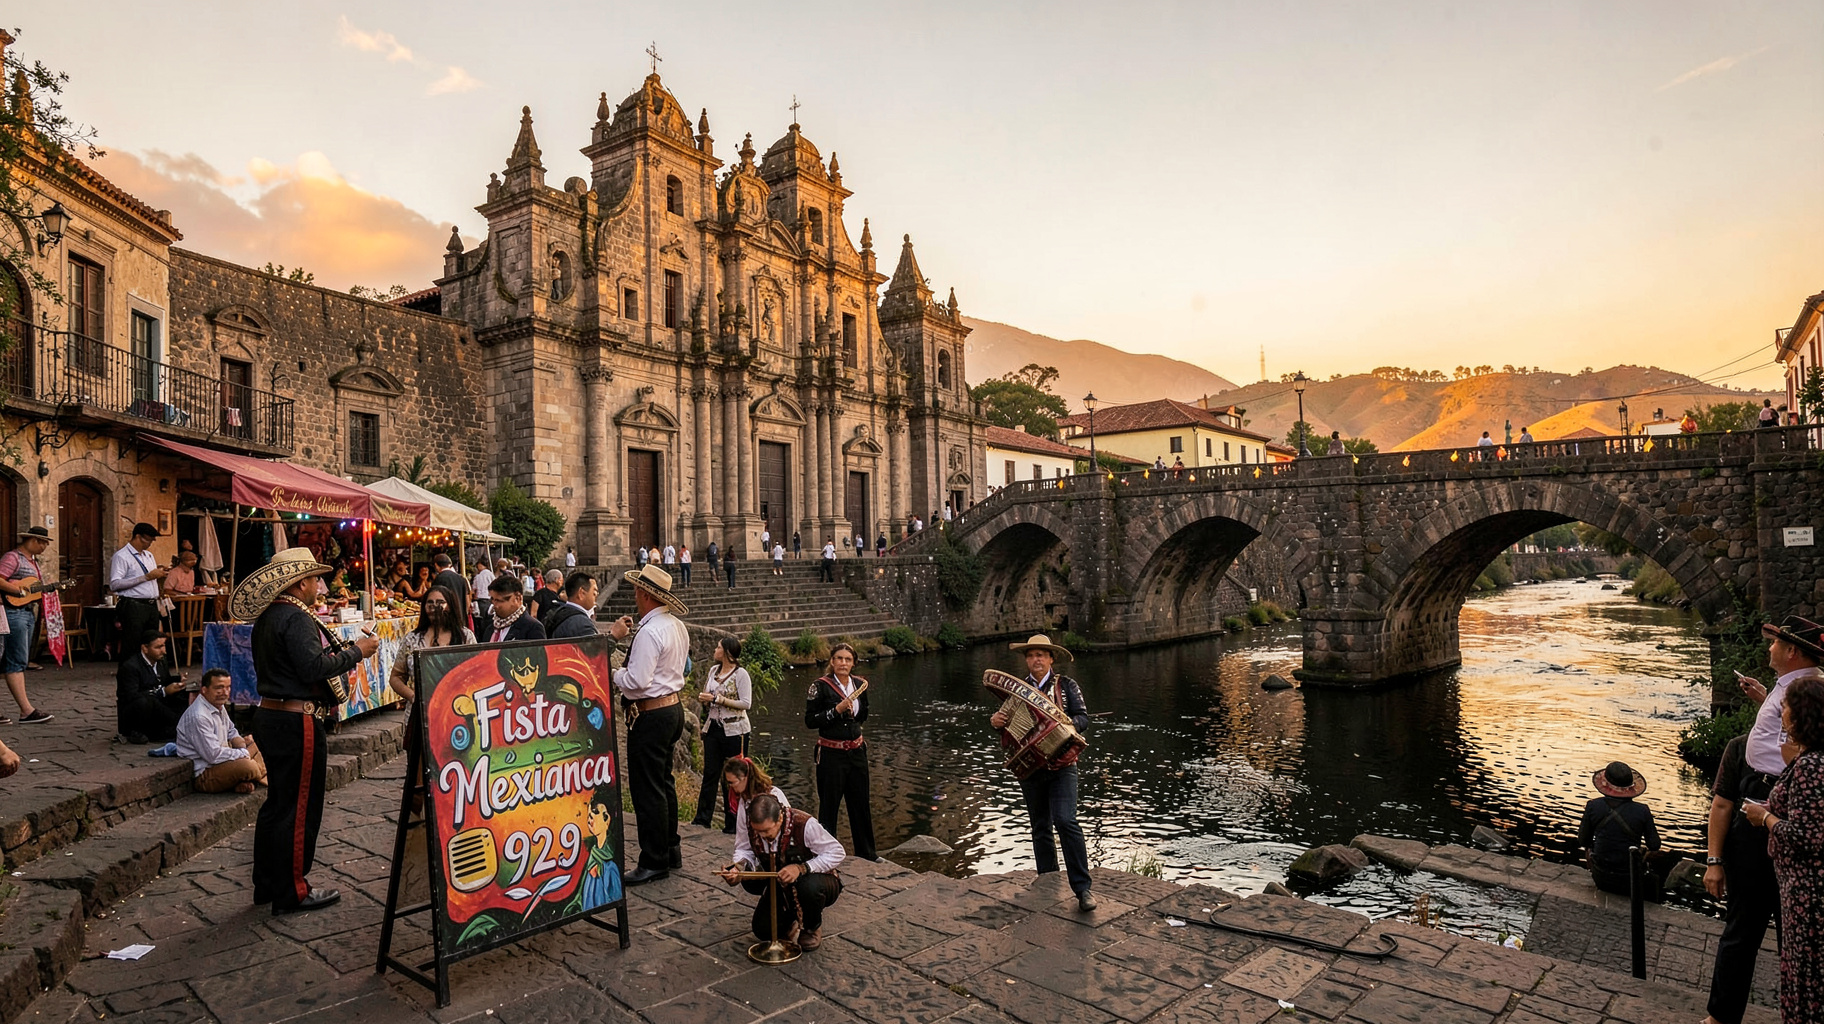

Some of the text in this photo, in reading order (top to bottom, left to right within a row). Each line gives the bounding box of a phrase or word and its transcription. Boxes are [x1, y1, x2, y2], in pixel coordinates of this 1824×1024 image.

[473, 682, 571, 749] Fista
[439, 753, 611, 824] Mexianca
[503, 822, 582, 885] 929
